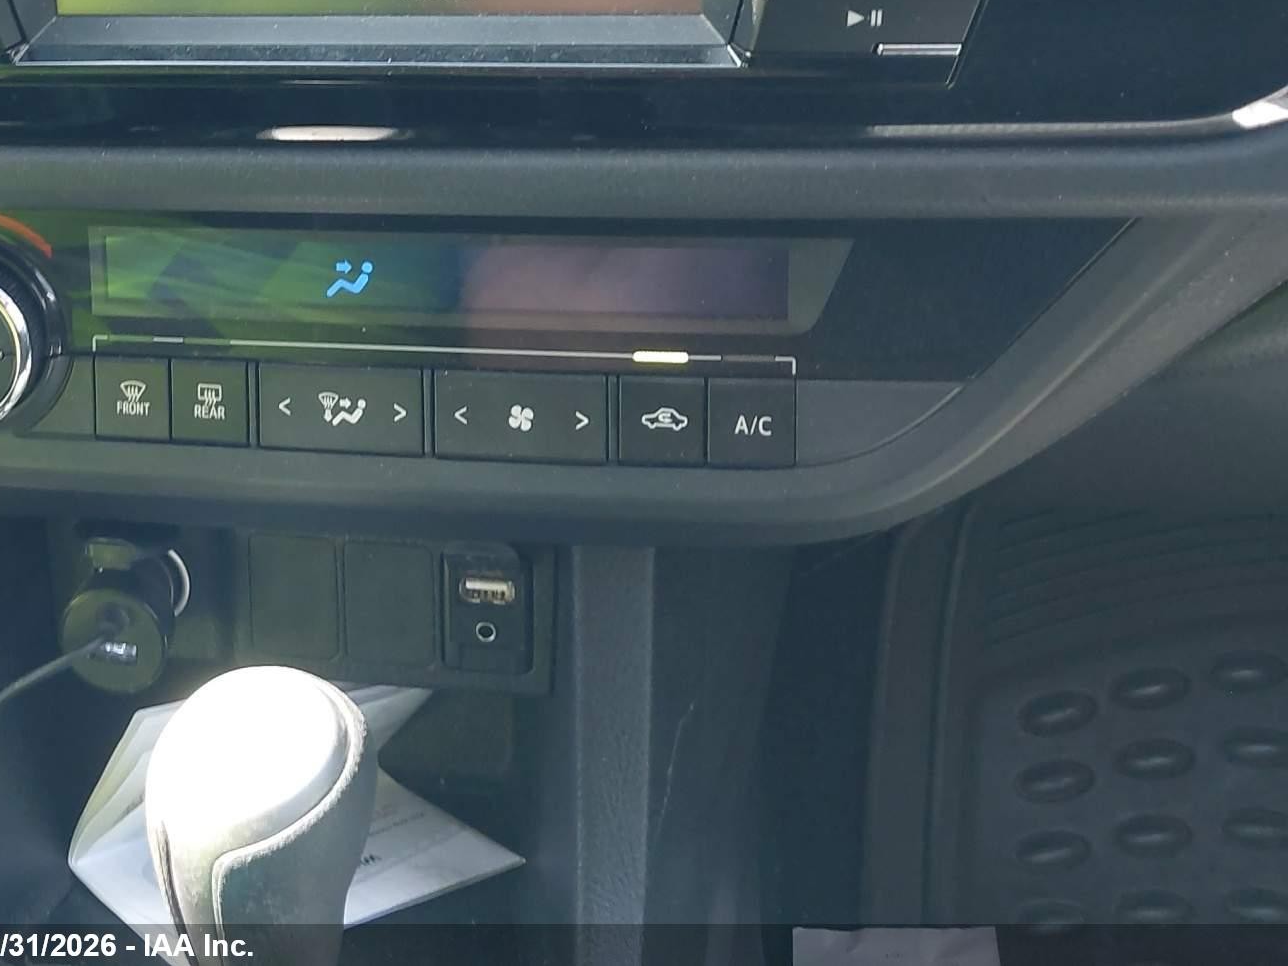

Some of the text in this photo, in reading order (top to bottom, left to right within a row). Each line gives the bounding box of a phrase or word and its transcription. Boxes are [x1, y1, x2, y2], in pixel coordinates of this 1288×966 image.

[116, 400, 151, 417] FRONT
[193, 403, 226, 420] REAR
[734, 414, 772, 436] A/C
